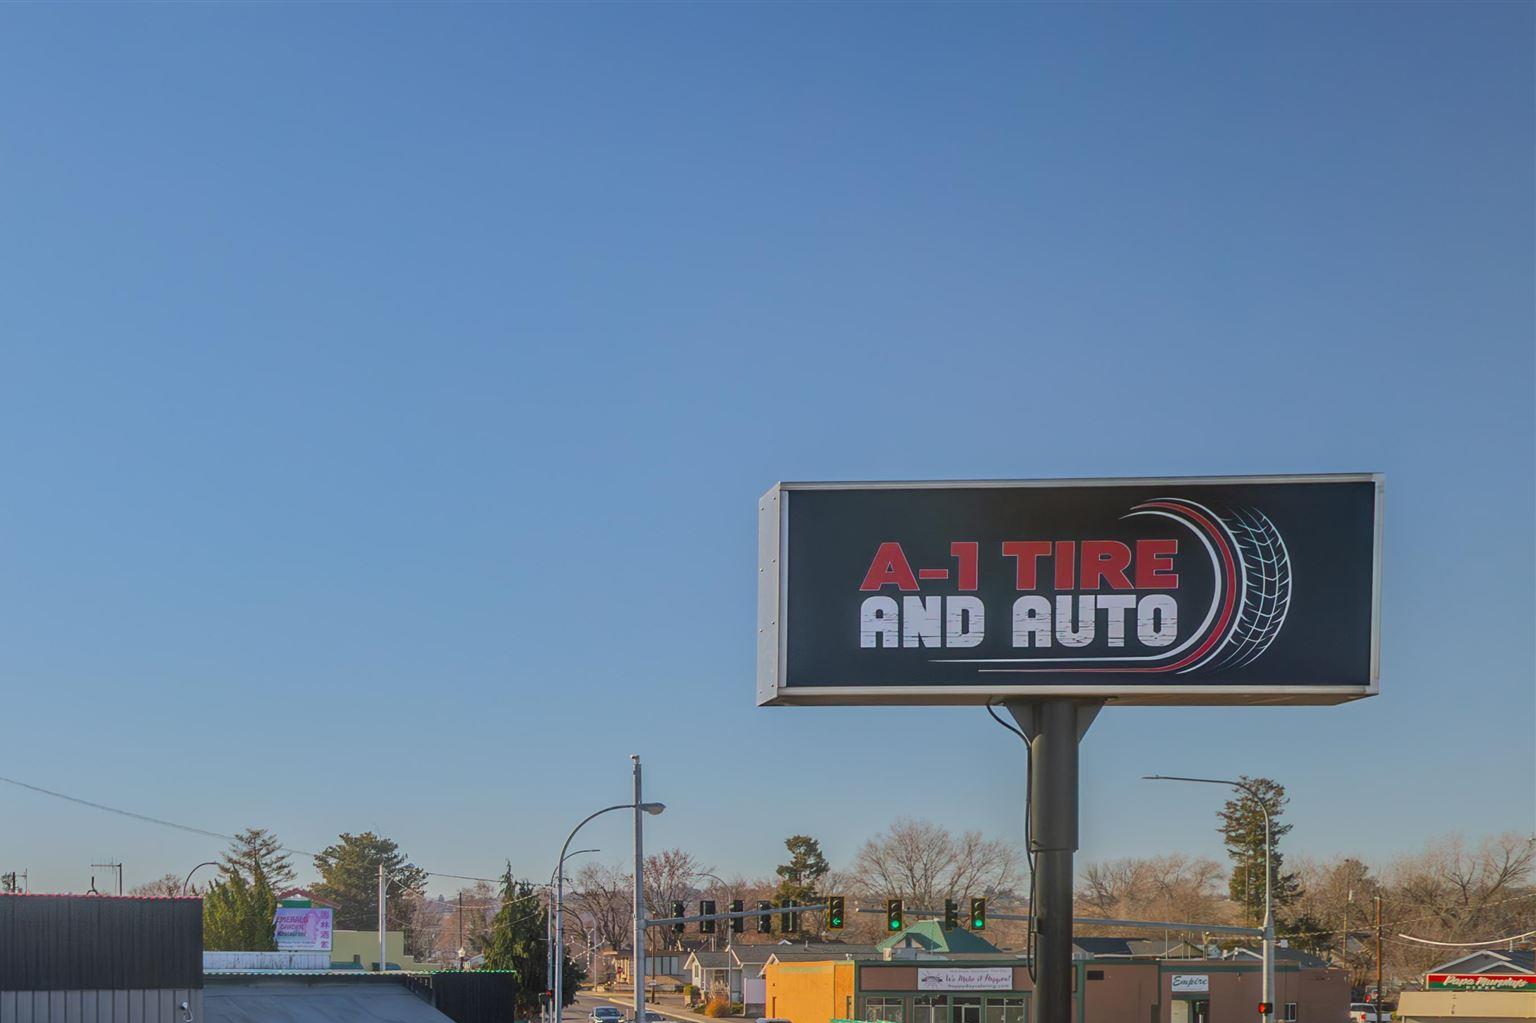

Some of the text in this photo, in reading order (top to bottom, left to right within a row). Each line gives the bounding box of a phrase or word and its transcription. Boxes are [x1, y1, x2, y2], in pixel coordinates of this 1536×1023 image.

[859, 539, 1179, 591] A-1 TIRE
[860, 594, 1178, 648] AND AUTO
[1173, 975, 1207, 987] Empire
[1443, 975, 1475, 986] Papa
